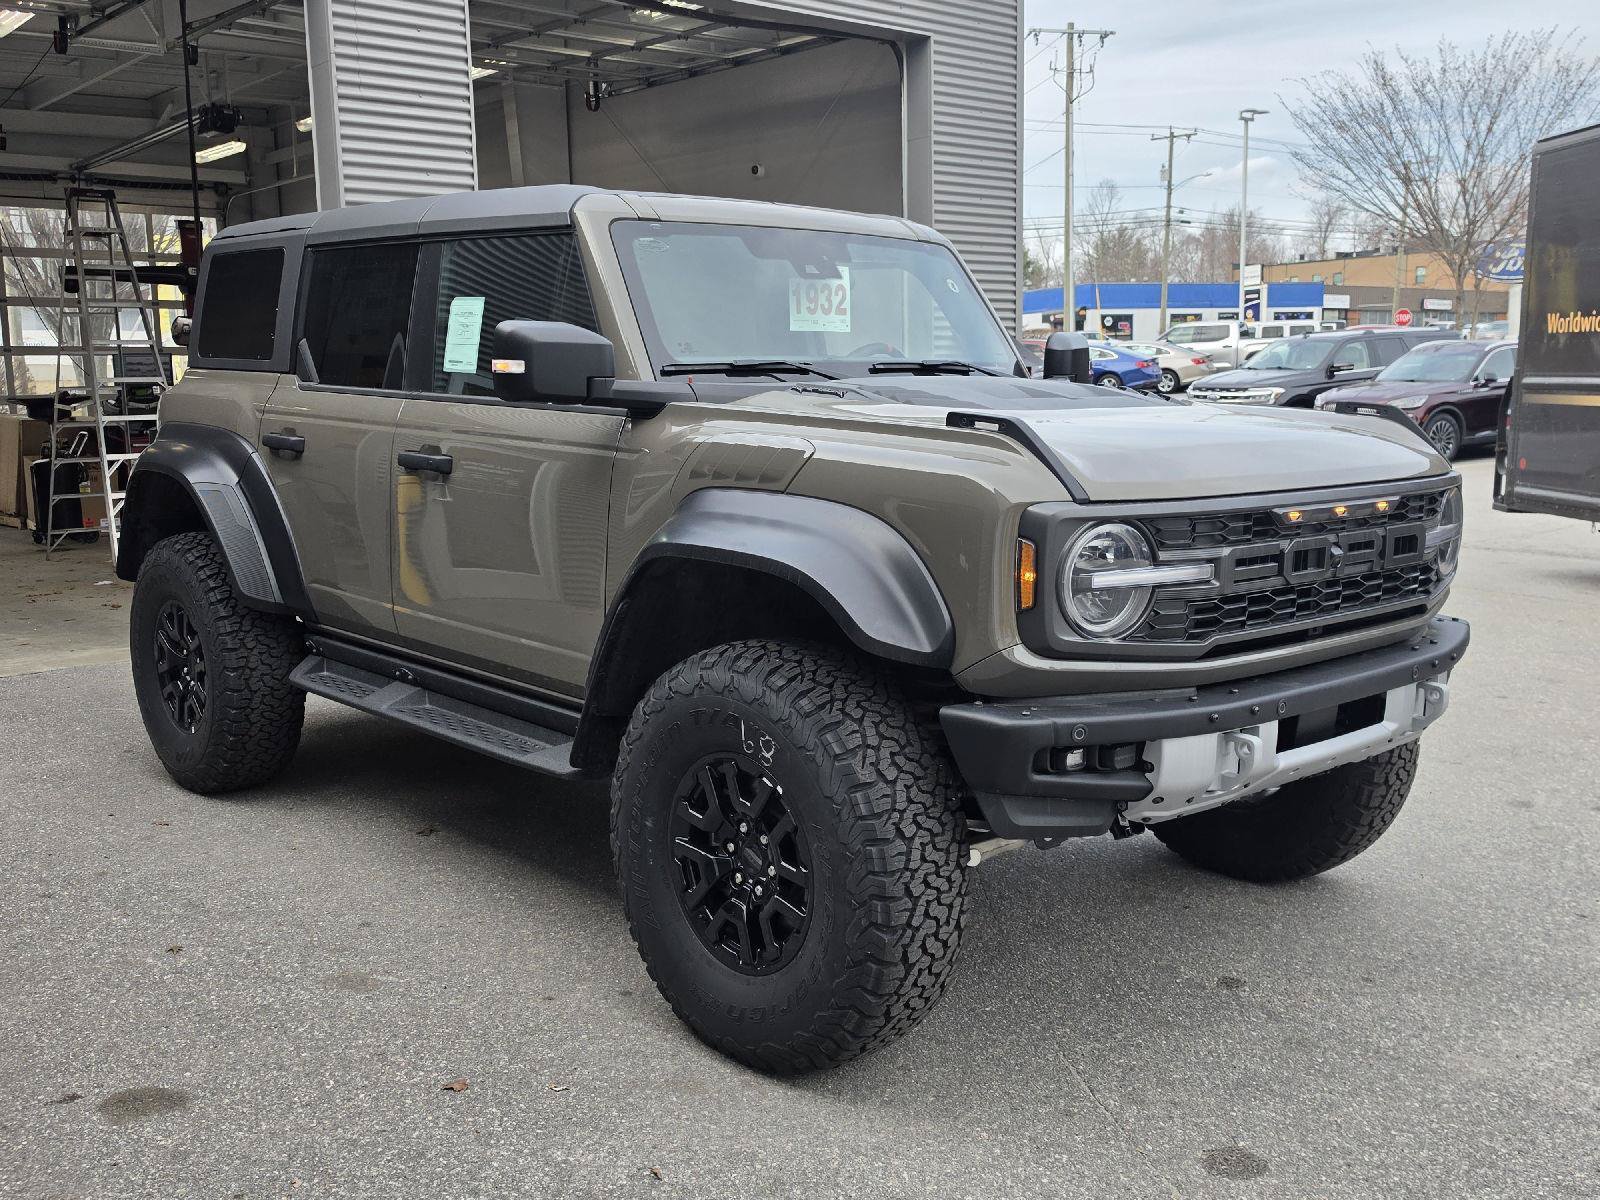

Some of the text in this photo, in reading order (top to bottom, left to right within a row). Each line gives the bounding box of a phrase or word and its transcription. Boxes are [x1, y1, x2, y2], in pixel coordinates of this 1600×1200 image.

[792, 282, 848, 316] 1932
[1395, 313, 1411, 323] STOP
[1219, 522, 1427, 594] FORD
